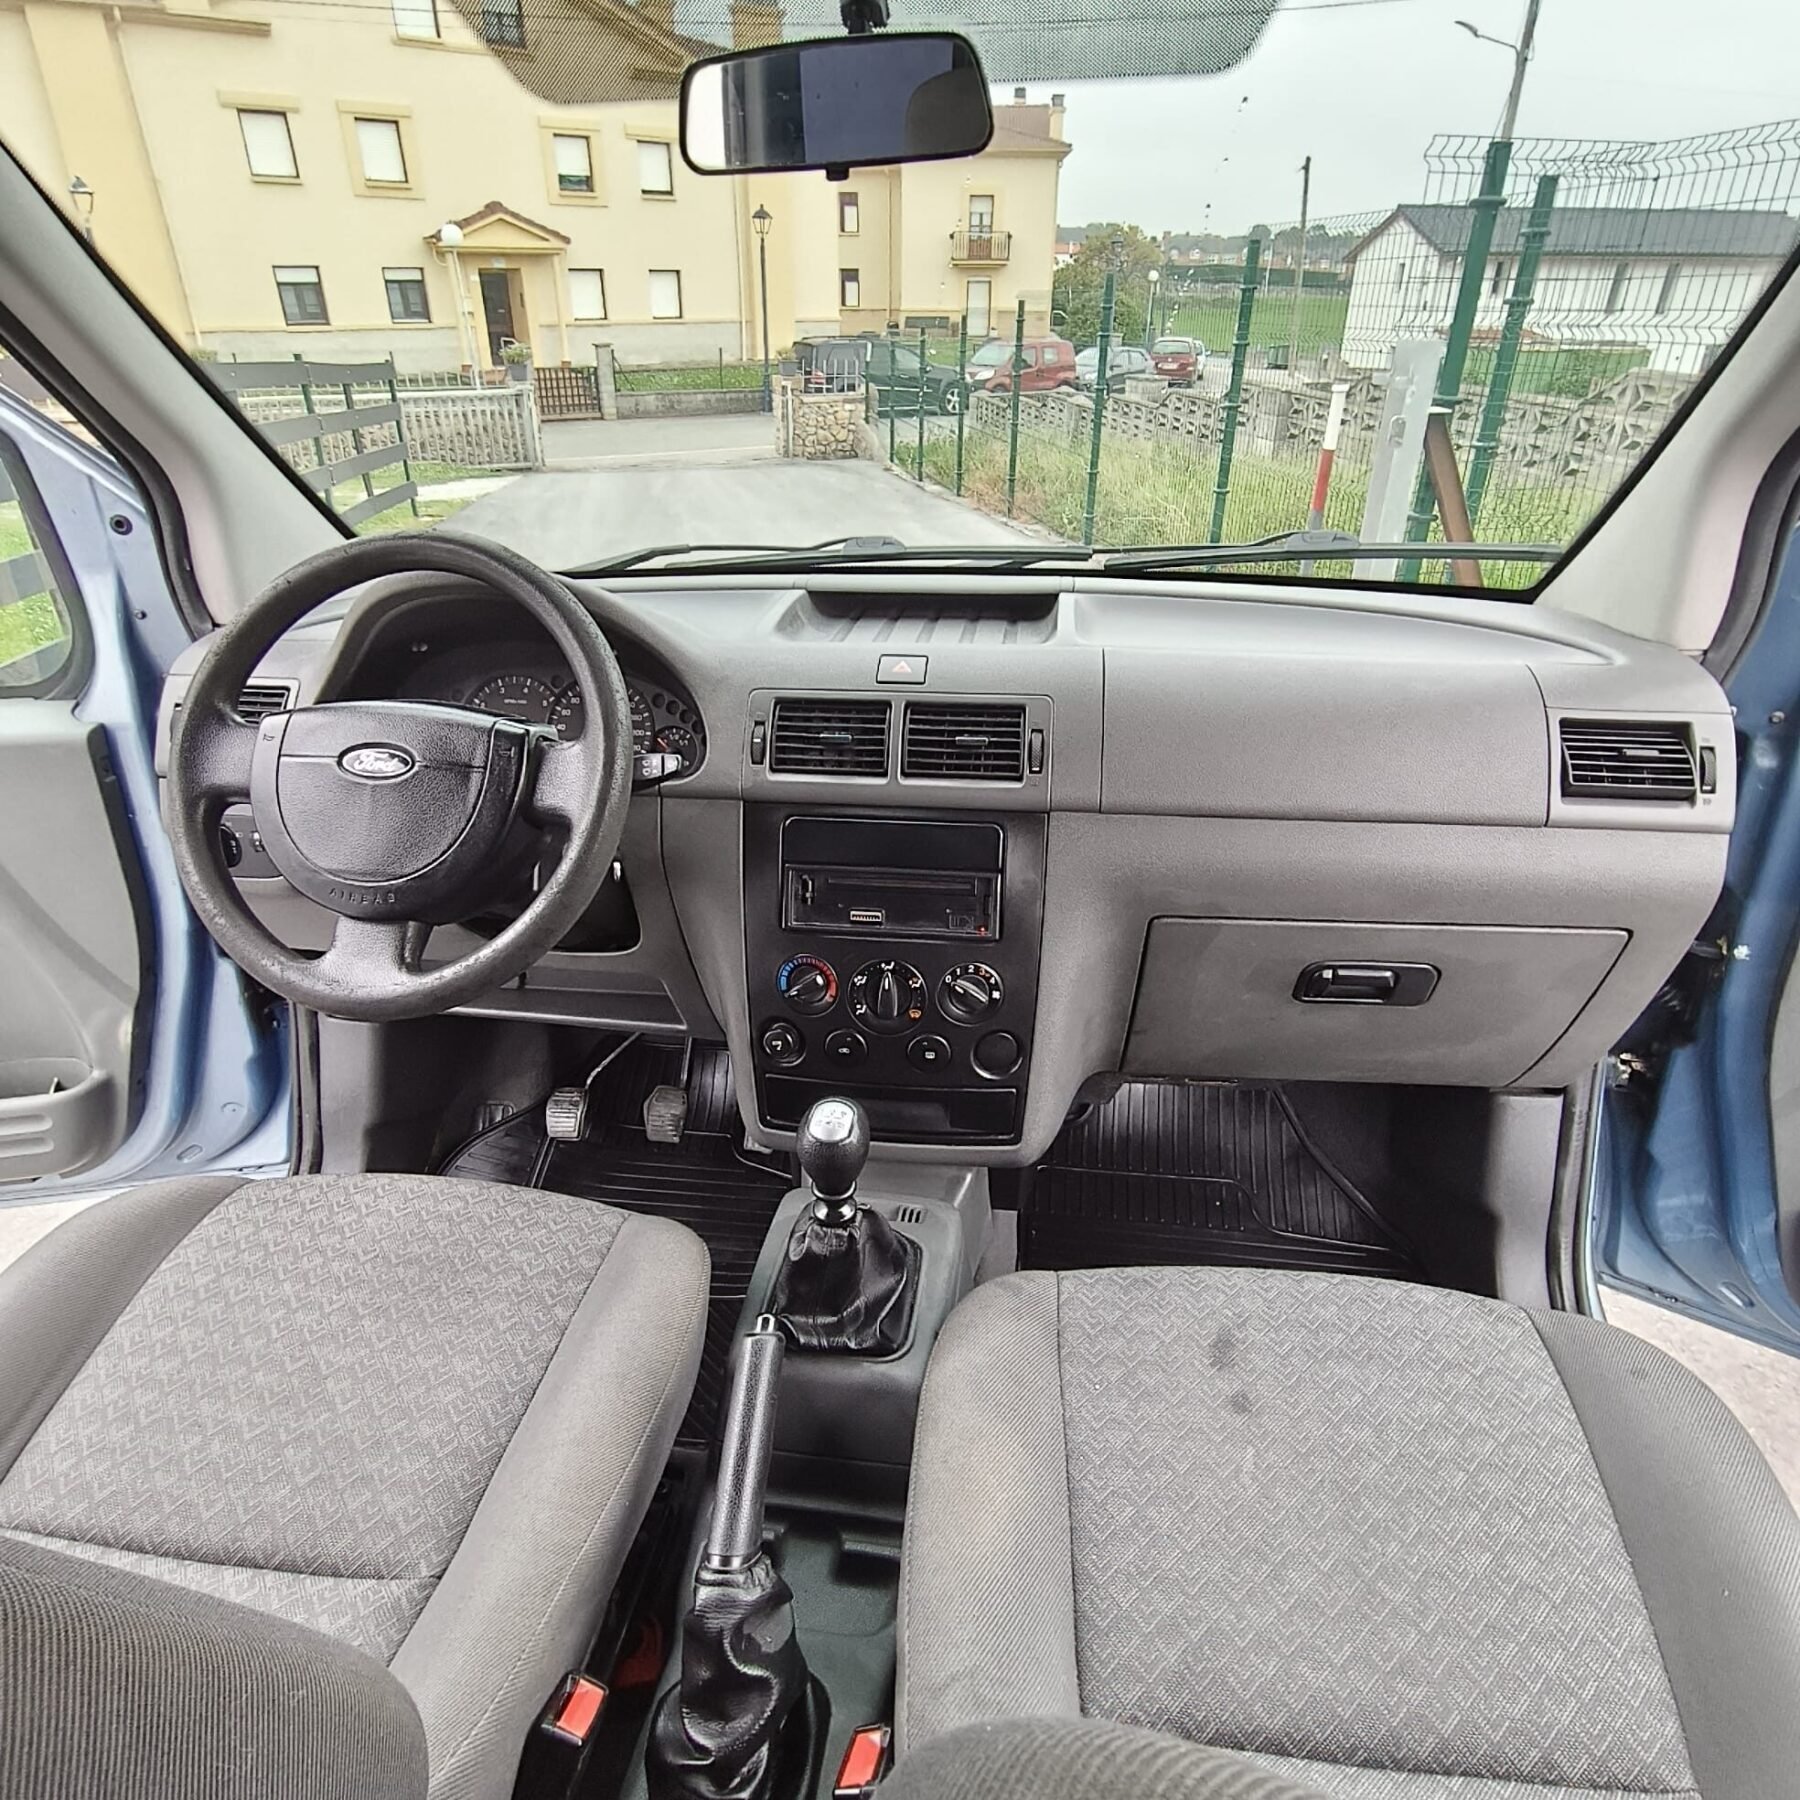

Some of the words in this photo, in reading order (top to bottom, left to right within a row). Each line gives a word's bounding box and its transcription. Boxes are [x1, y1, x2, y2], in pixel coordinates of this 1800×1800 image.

[353, 751, 404, 771] Ford
[945, 975, 952, 983] 0
[956, 967, 961, 976] 1
[967, 964, 975, 973] 2
[989, 976, 996, 985] 4
